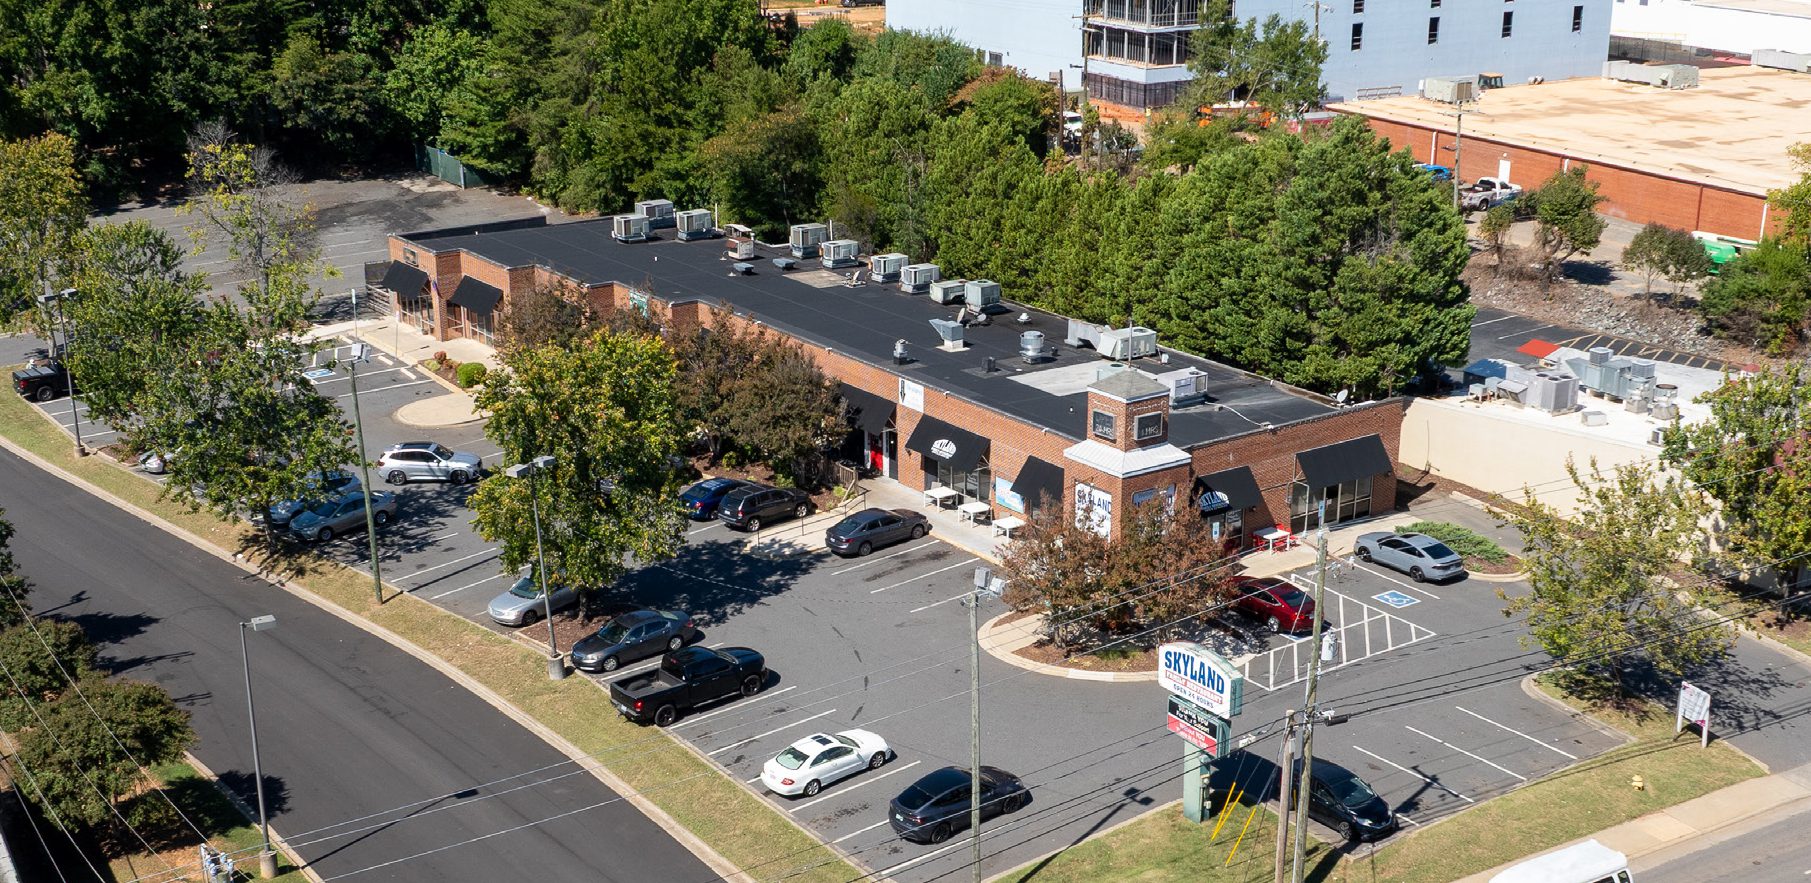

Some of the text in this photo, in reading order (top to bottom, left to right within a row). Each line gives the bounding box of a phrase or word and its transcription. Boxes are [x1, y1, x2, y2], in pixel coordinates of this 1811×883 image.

[1165, 651, 1225, 694] SKYLAND
[1173, 683, 1187, 695] OPEN
[1196, 695, 1214, 709] HOURS
